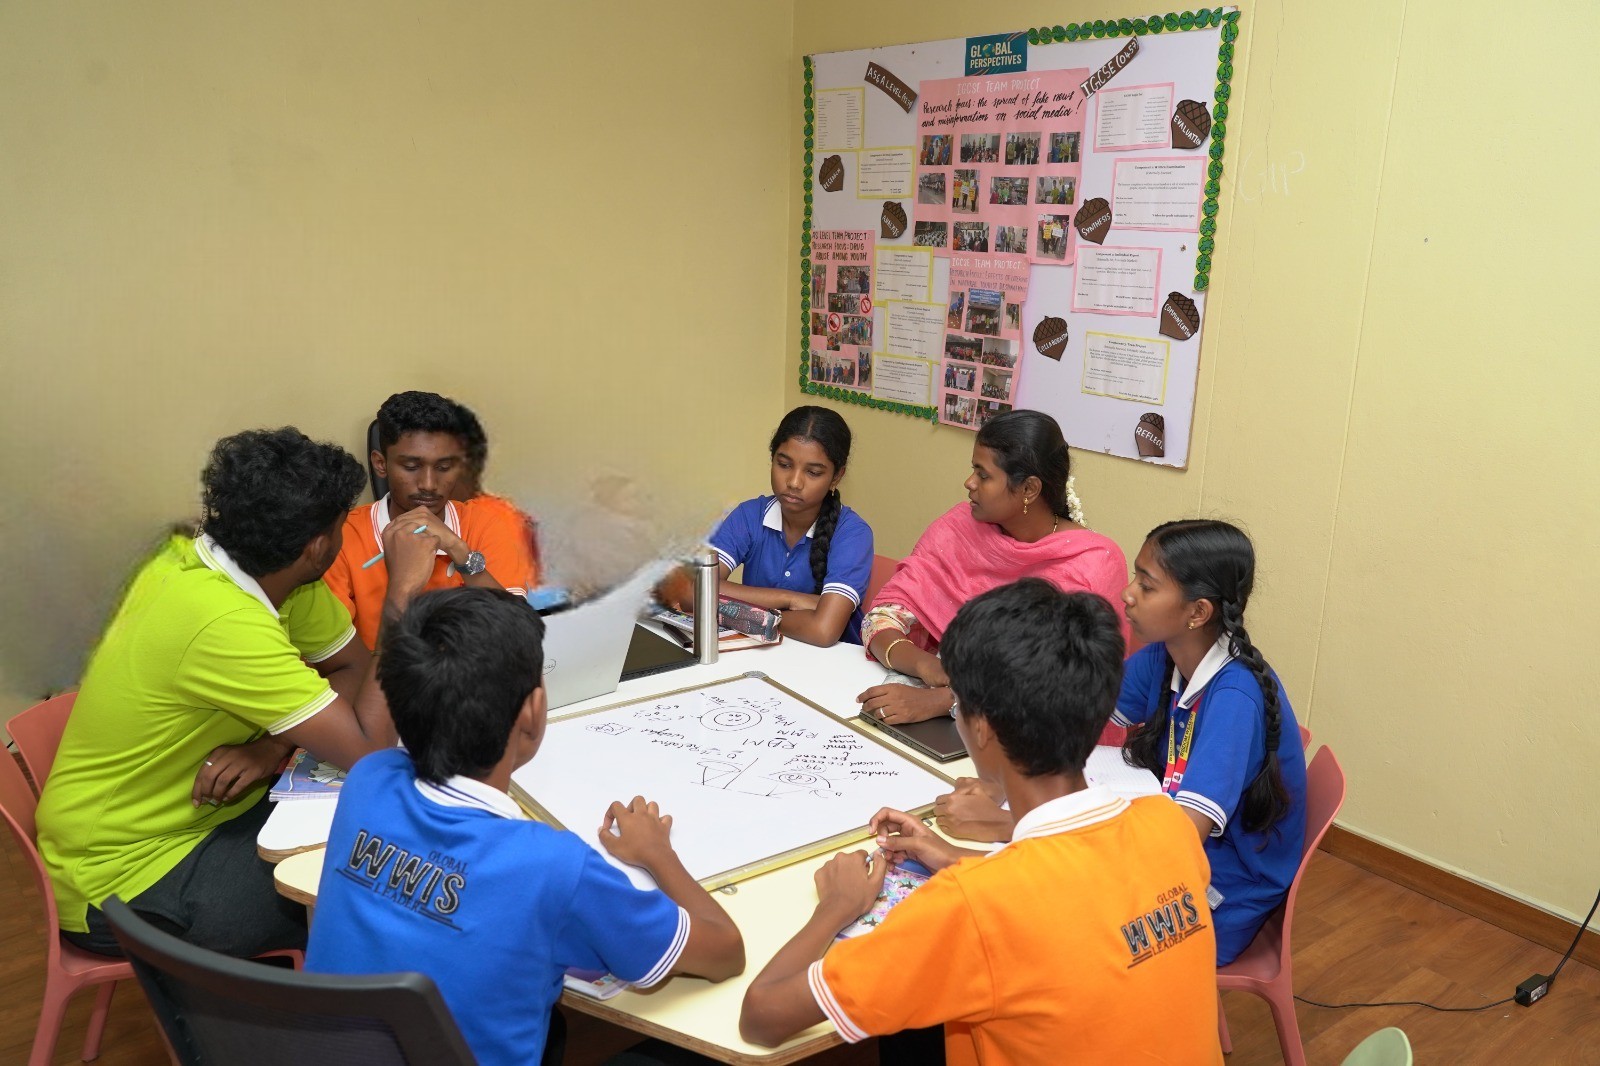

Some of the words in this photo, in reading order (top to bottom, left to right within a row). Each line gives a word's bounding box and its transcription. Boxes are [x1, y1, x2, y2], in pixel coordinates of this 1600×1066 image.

[970, 54, 1022, 69] PERSPECTIVES
[986, 80, 1008, 93] TEAM
[1011, 78, 1041, 92] PROJECT
[1080, 61, 1117, 100] IGCSE
[977, 96, 988, 109] the
[993, 93, 1018, 108] spread
[1021, 92, 1030, 105] of
[1033, 92, 1050, 106] fake
[1052, 90, 1075, 102] news
[921, 117, 935, 128] and
[995, 111, 1007, 121] on
[1015, 107, 1040, 121] social
[832, 231, 844, 241] TEAM
[1081, 212, 1111, 237] SYNTHESIS
[951, 257, 970, 267] IGCSE
[974, 258, 991, 269] TEAM
[348, 828, 466, 916] WWIS
[428, 851, 469, 875] GLOBAL
[373, 882, 421, 913] LEADER
[1156, 882, 1189, 905] GLOBAL
[1120, 891, 1199, 957] WWIS
[1151, 932, 1186, 956] LEADER
